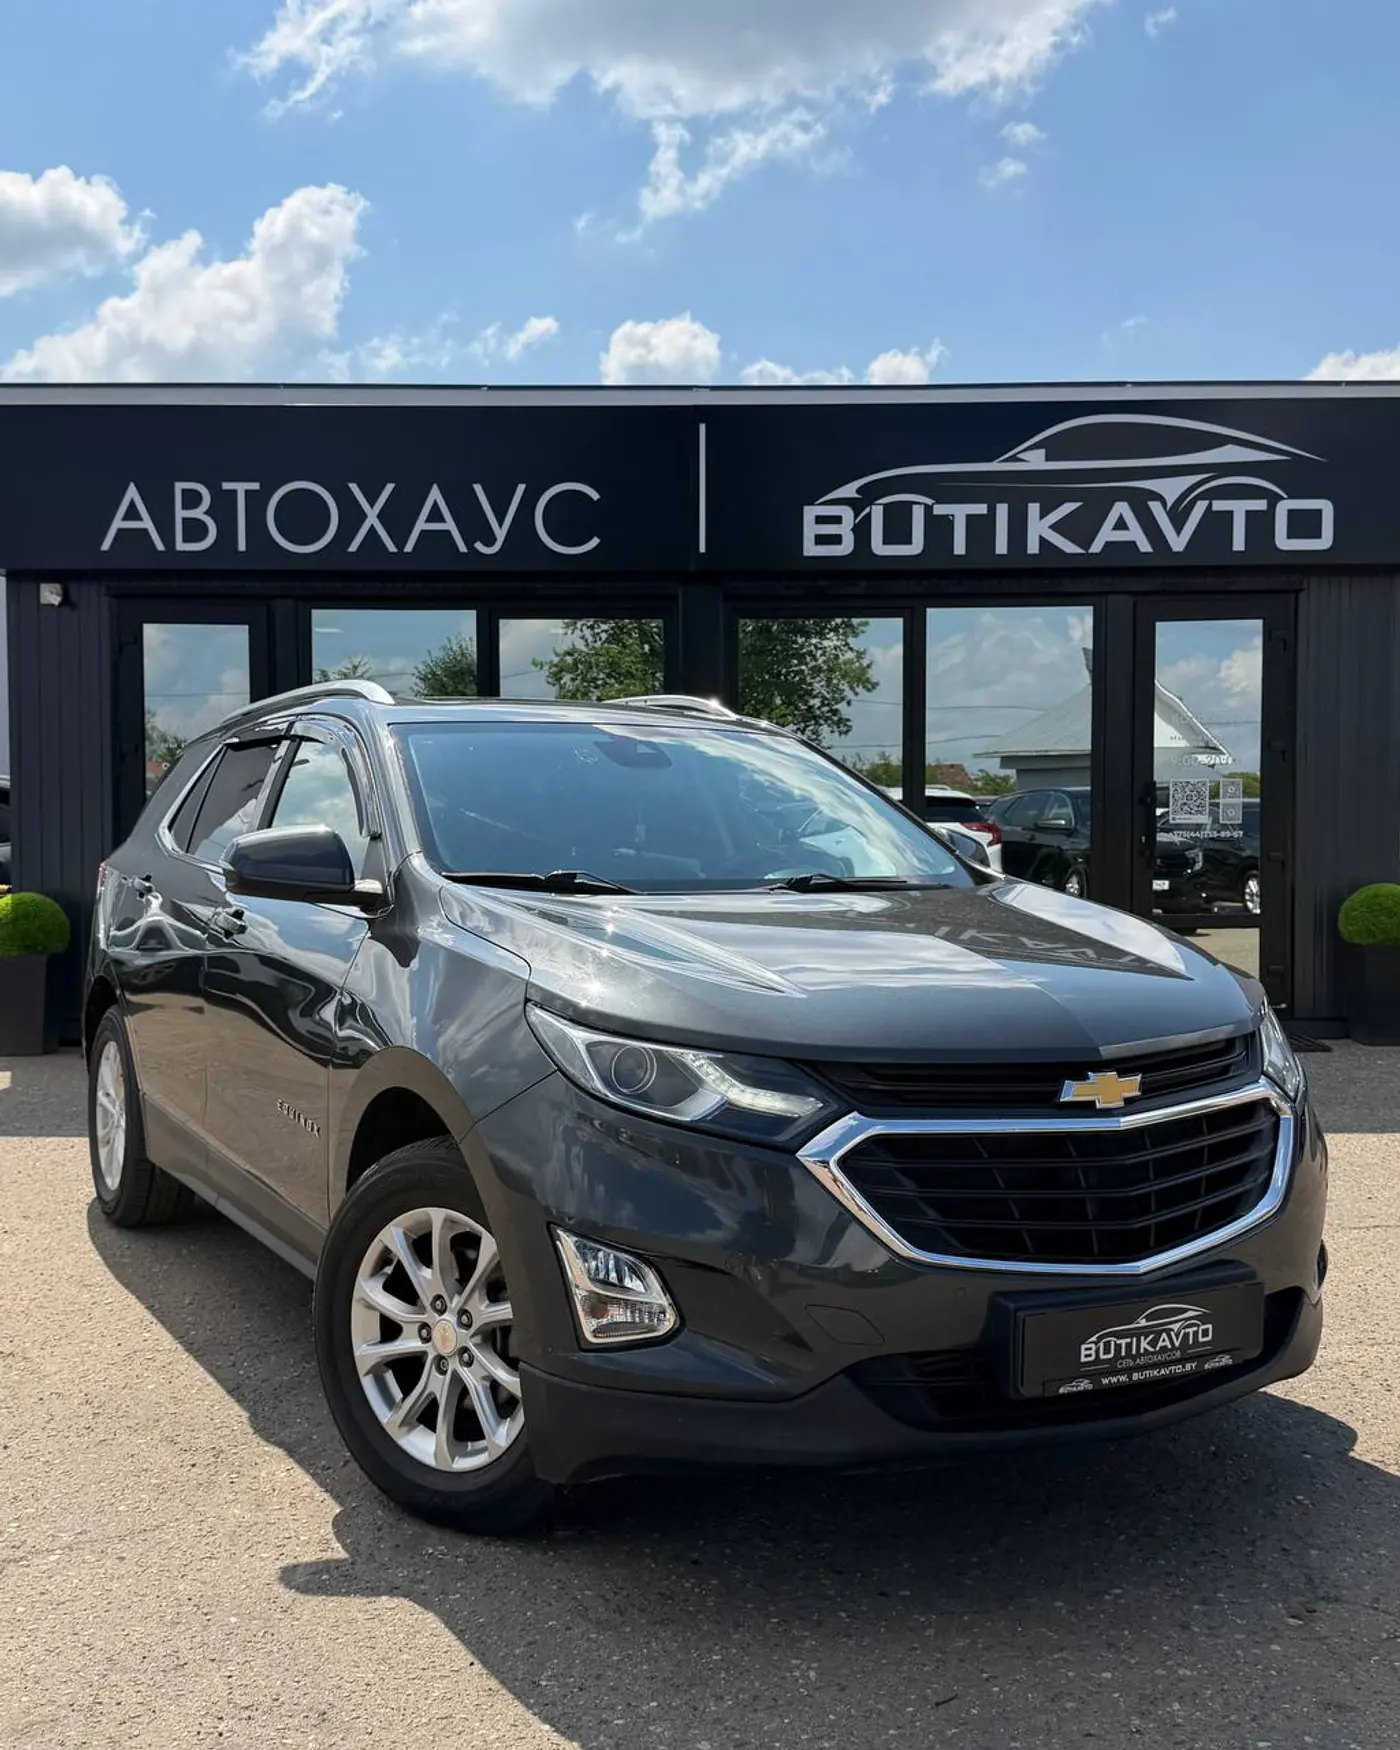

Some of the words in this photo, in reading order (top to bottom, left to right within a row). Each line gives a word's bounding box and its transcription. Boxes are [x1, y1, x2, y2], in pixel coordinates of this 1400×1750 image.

[100, 480, 602, 555] АВТОХАУС
[802, 498, 1334, 557] BUTIKAVTO
[1080, 1323, 1213, 1363] BUTIKAVTO
